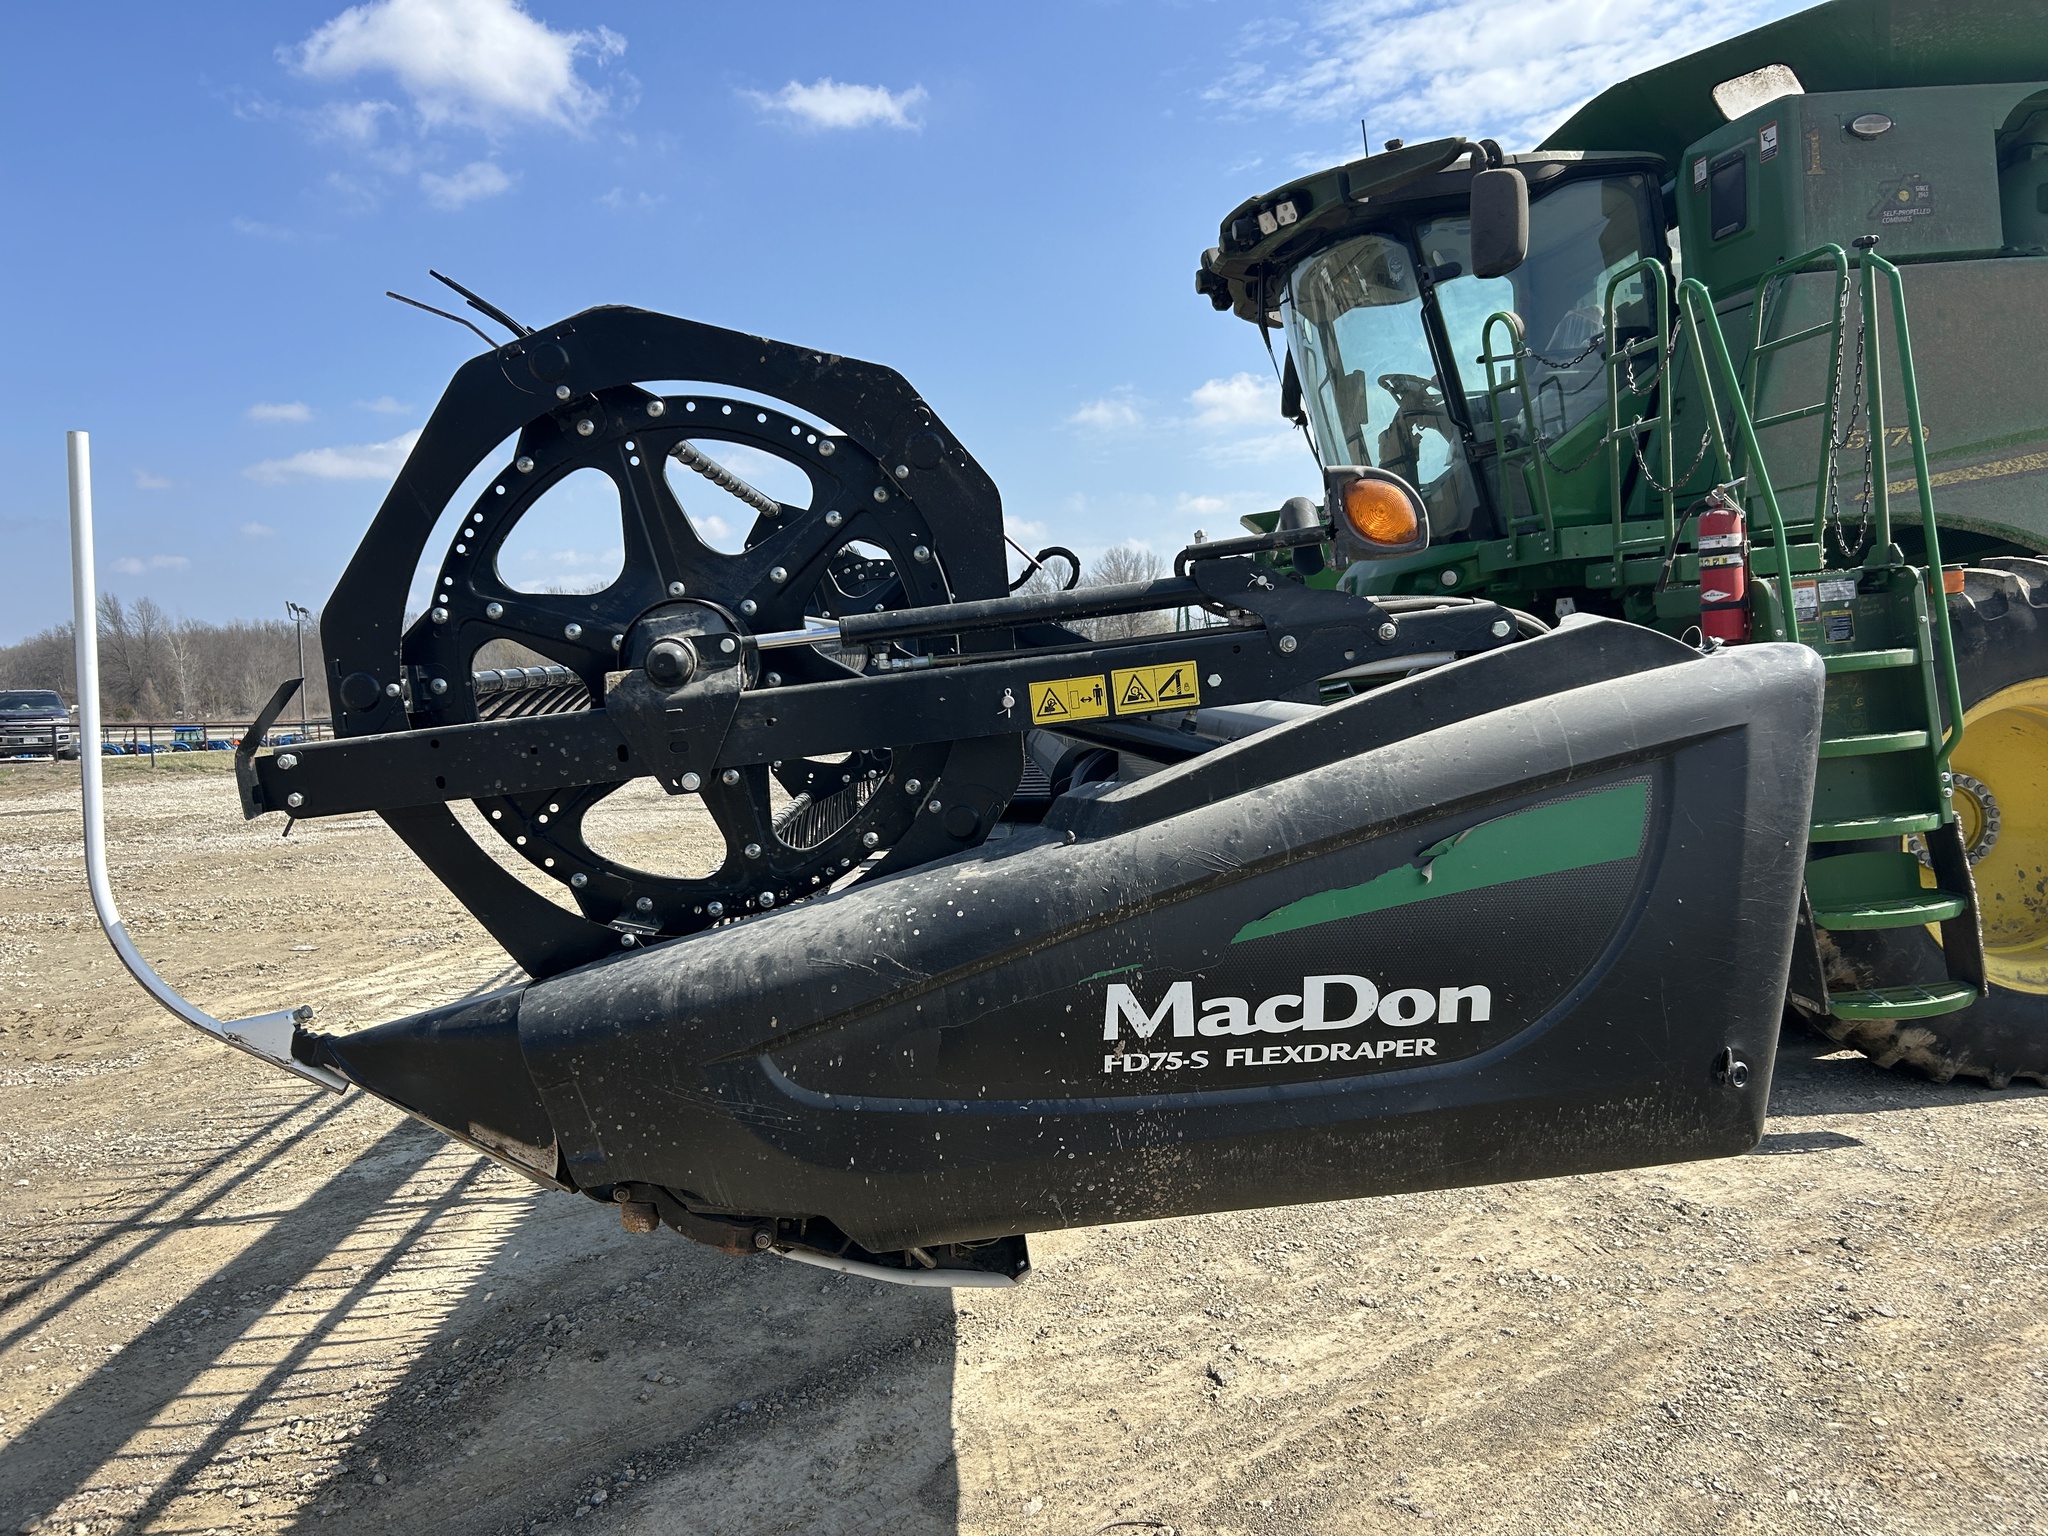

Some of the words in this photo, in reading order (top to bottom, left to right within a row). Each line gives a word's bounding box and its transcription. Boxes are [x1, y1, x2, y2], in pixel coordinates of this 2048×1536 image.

[1915, 184, 1930, 192] SINCE
[1882, 215, 1913, 224] COMBINES
[1883, 207, 1932, 218] SELF-PROPELLED
[1846, 425, 1930, 449] S70
[1103, 974, 1491, 1040] MacDon
[1103, 1050, 1209, 1074] FD75-S
[1225, 1038, 1437, 1068] FLEXDRAPER
